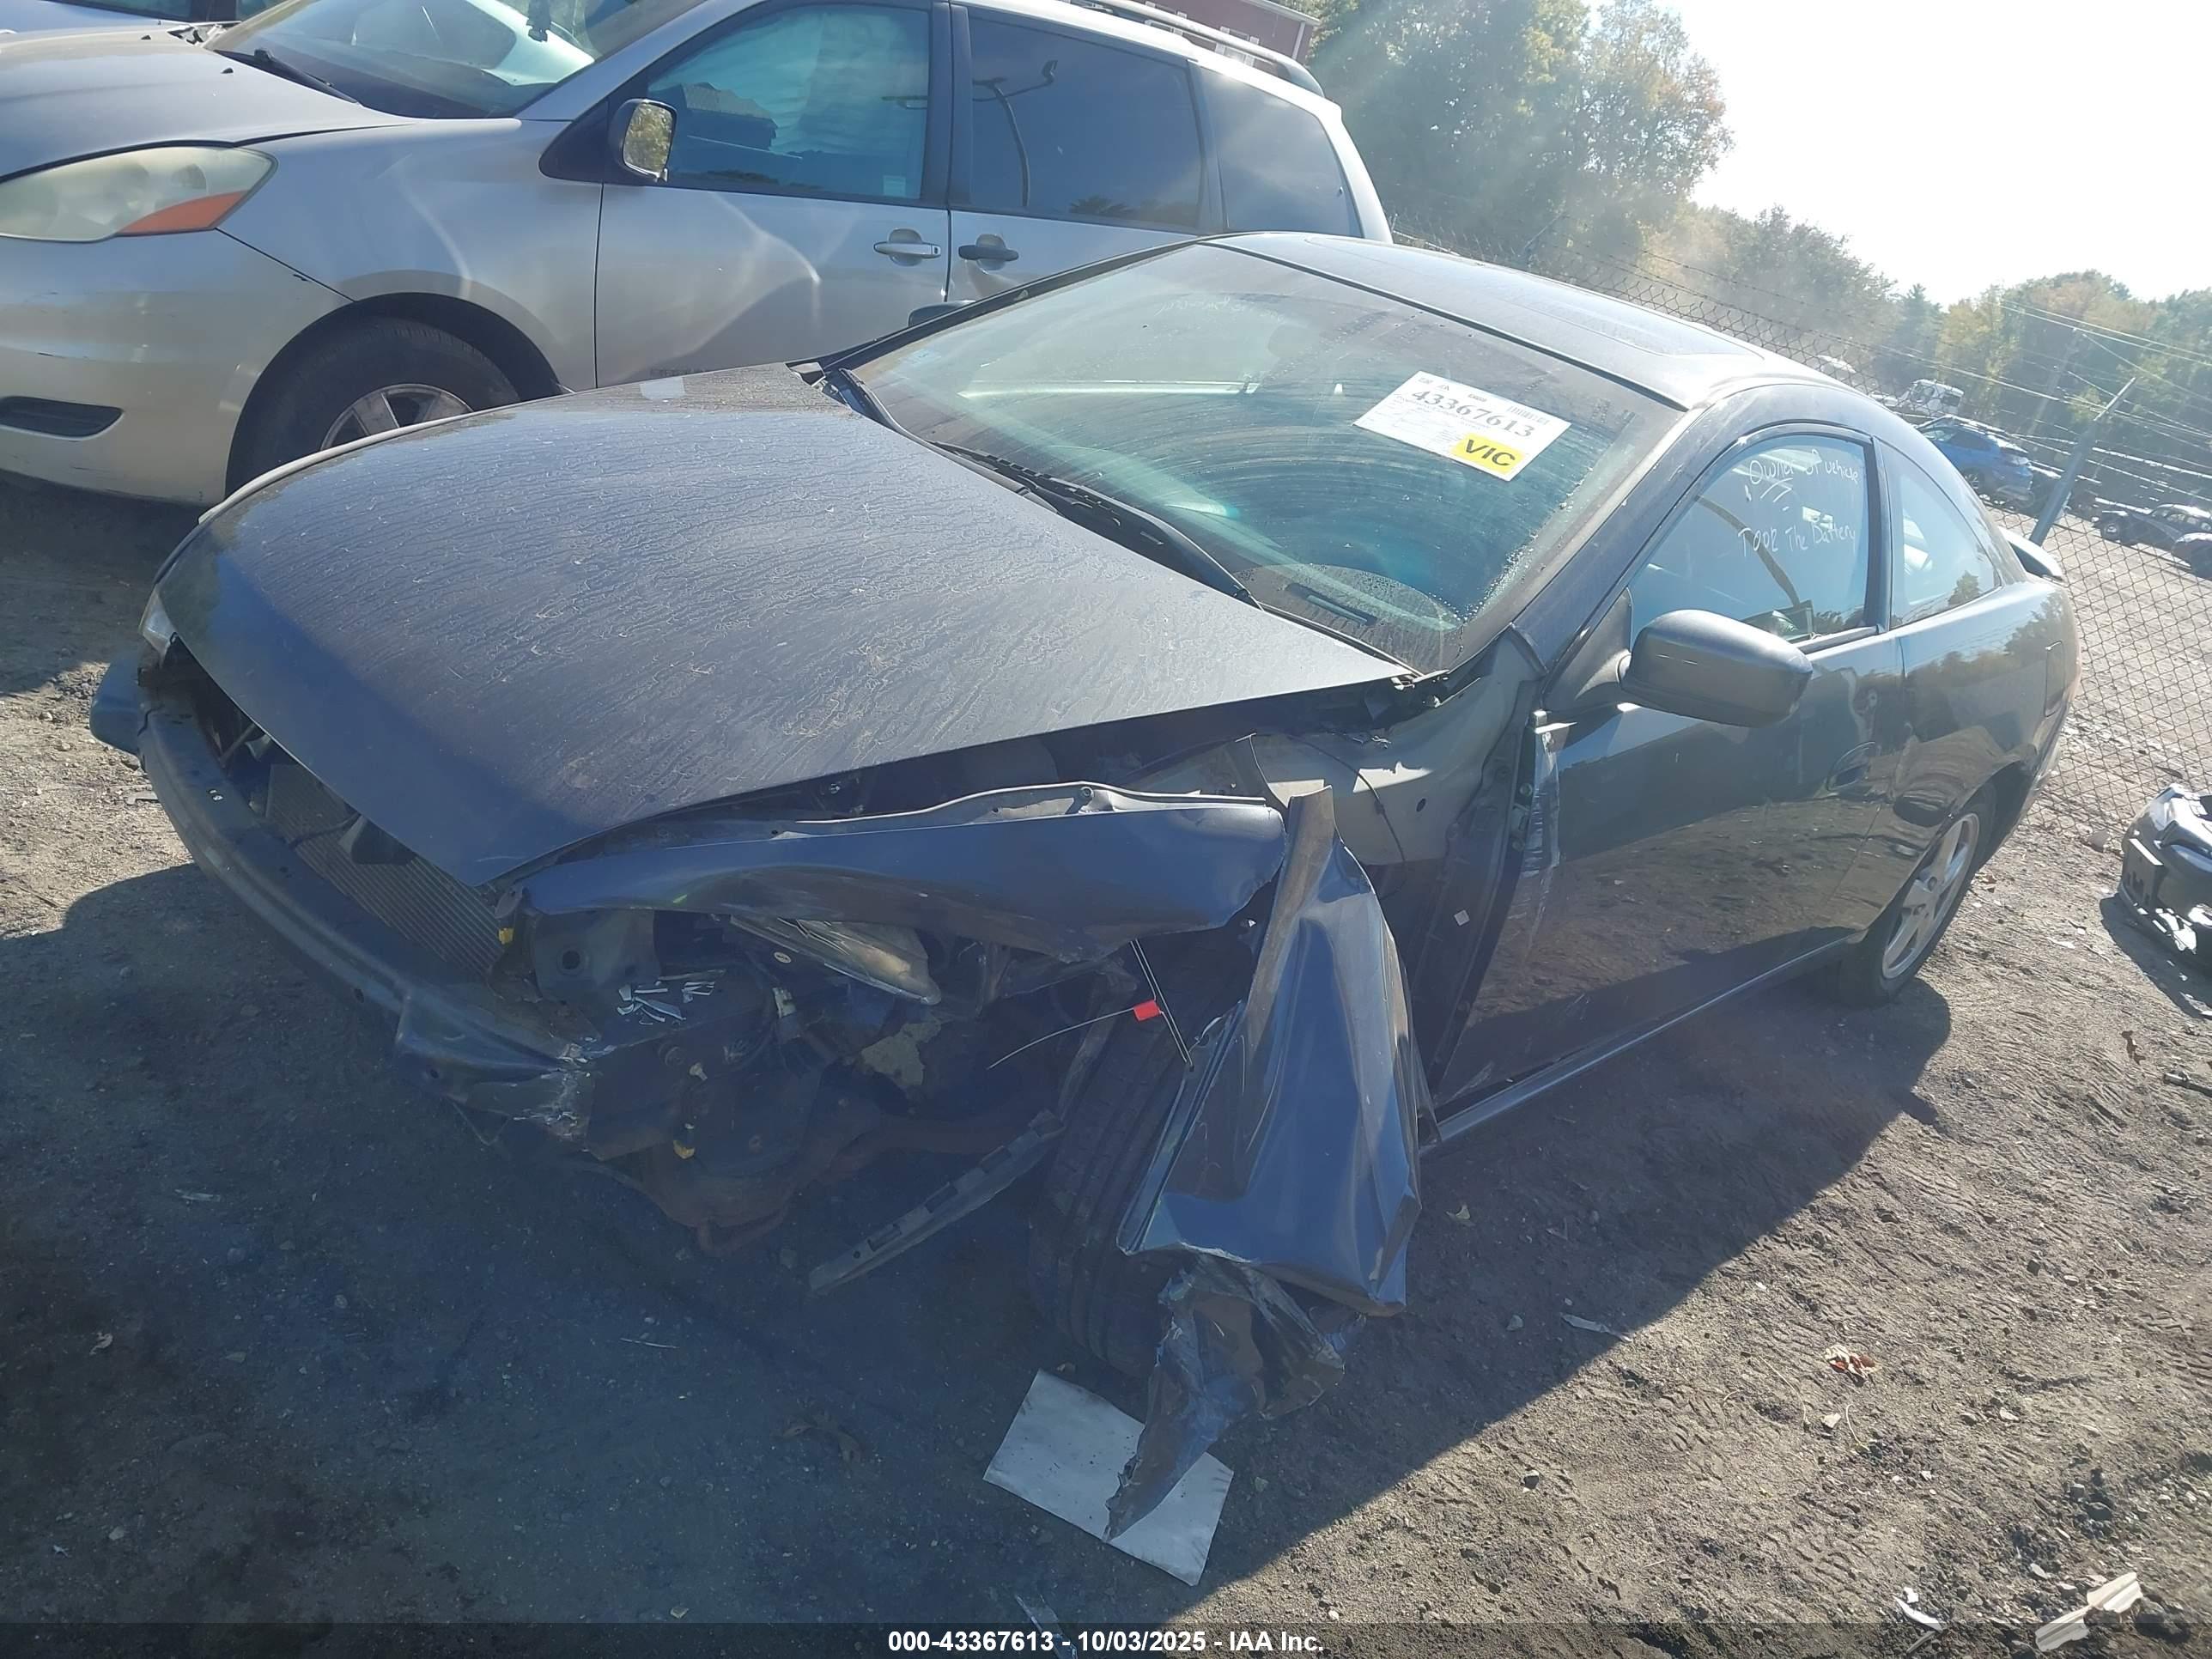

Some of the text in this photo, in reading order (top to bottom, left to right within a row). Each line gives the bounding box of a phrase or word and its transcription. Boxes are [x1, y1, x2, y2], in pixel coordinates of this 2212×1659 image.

[1411, 390, 1535, 437] 43367613
[1464, 439, 1516, 466] VIC
[1784, 524, 1808, 552] The
